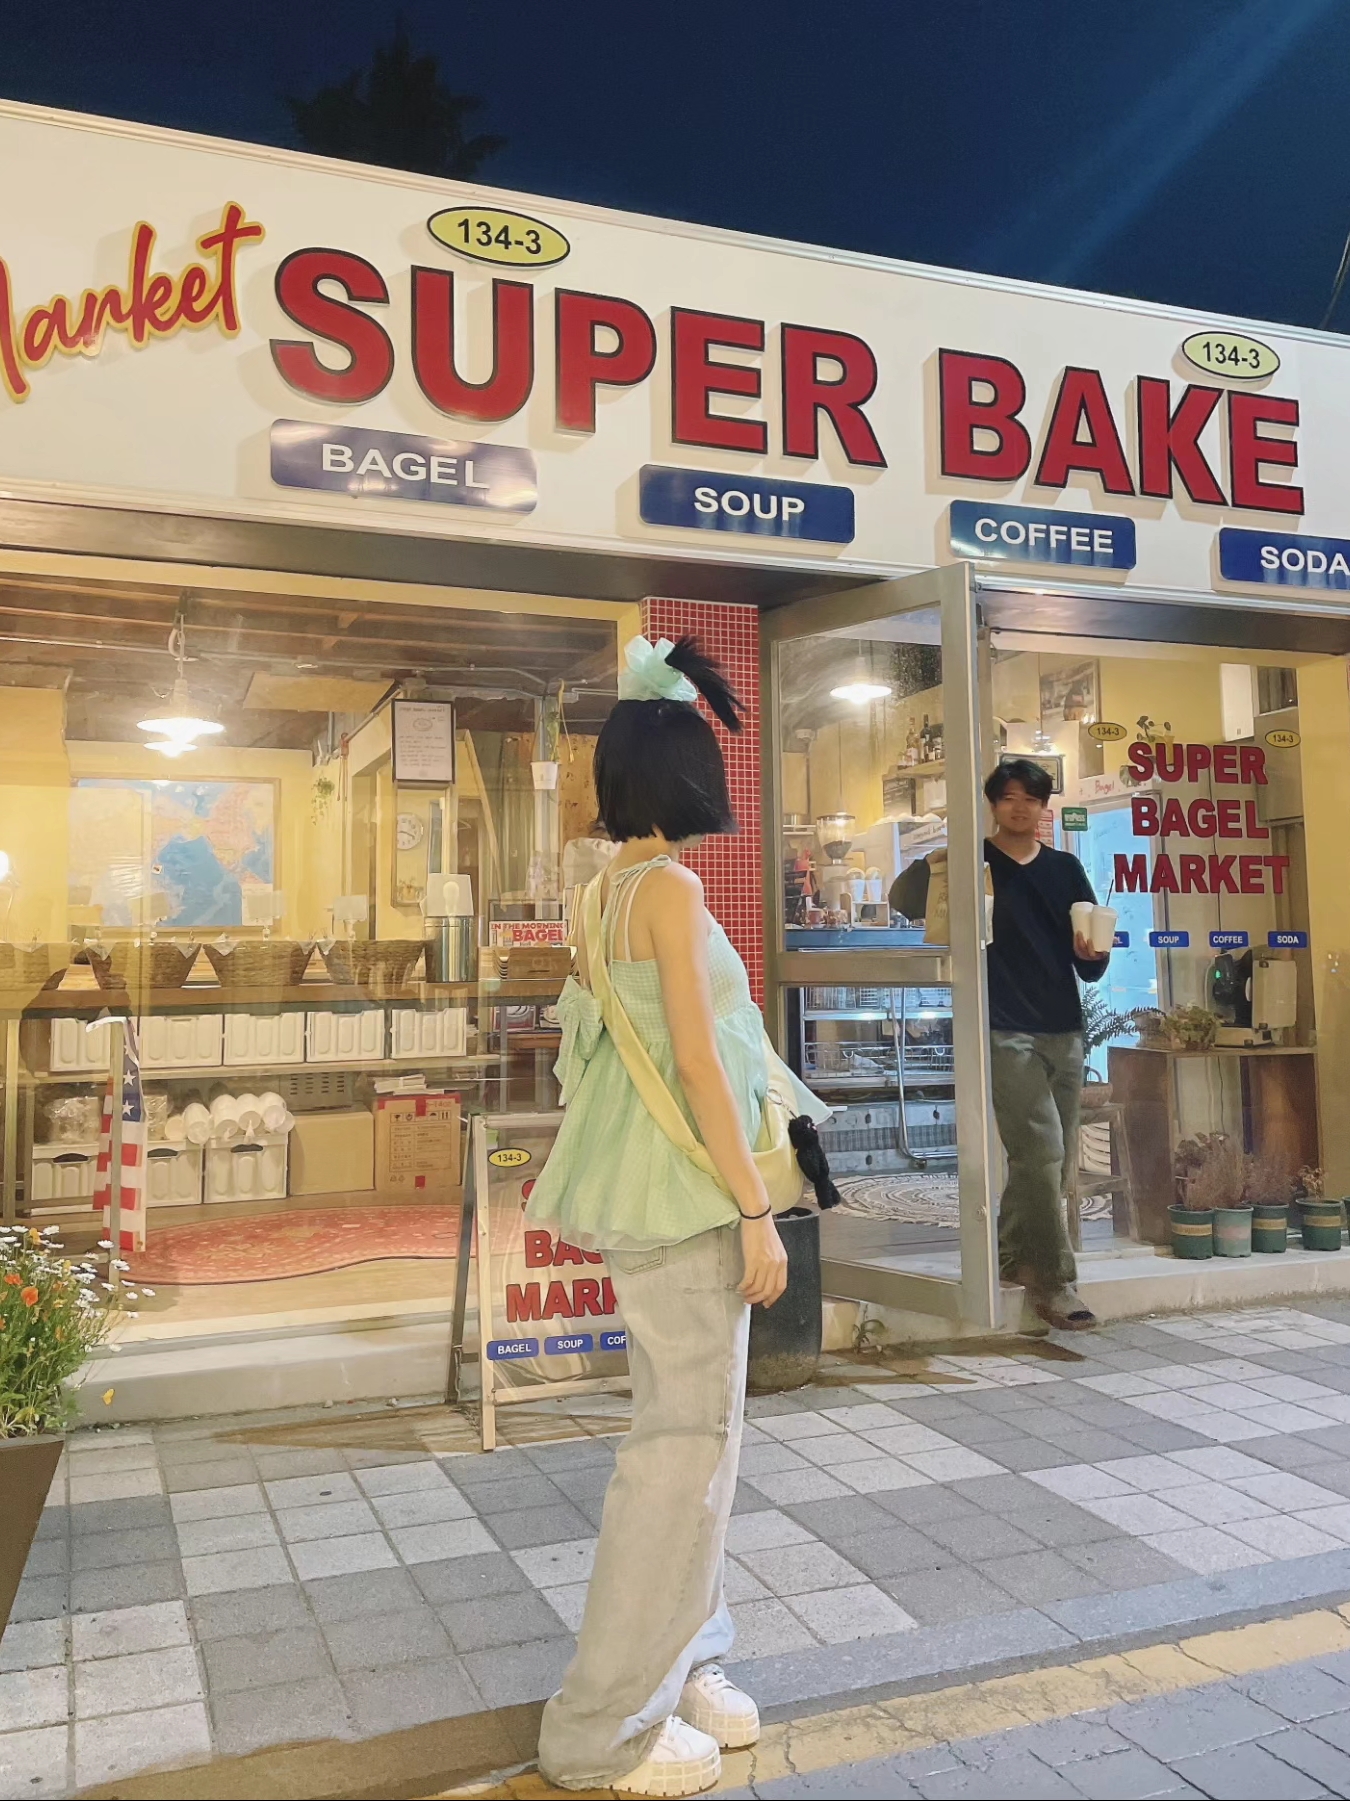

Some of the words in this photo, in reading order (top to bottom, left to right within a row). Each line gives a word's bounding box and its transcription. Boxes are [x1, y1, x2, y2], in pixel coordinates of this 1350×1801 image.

[456, 218, 543, 256] 134-3
[1202, 341, 1261, 369] 134-3
[269, 247, 888, 468] SUPER
[938, 347, 1306, 515] BAKE
[321, 443, 490, 490] BAGEL
[694, 486, 805, 522] SOUP
[974, 517, 1114, 554] COFFEE
[1260, 545, 1350, 575] SODA
[1097, 727, 1120, 737] 134-3
[1273, 733, 1294, 743] 134-3
[1128, 742, 1268, 784] SUPER
[1131, 797, 1269, 838] BAGEL
[1113, 853, 1290, 894] MARKET
[1157, 935, 1180, 944] SOUP
[1212, 935, 1243, 944] COFFEE
[1276, 935, 1299, 944] SODA
[497, 1153, 522, 1162] 134-3
[497, 1343, 532, 1355] BAGEL
[557, 1339, 584, 1350] SOUP
